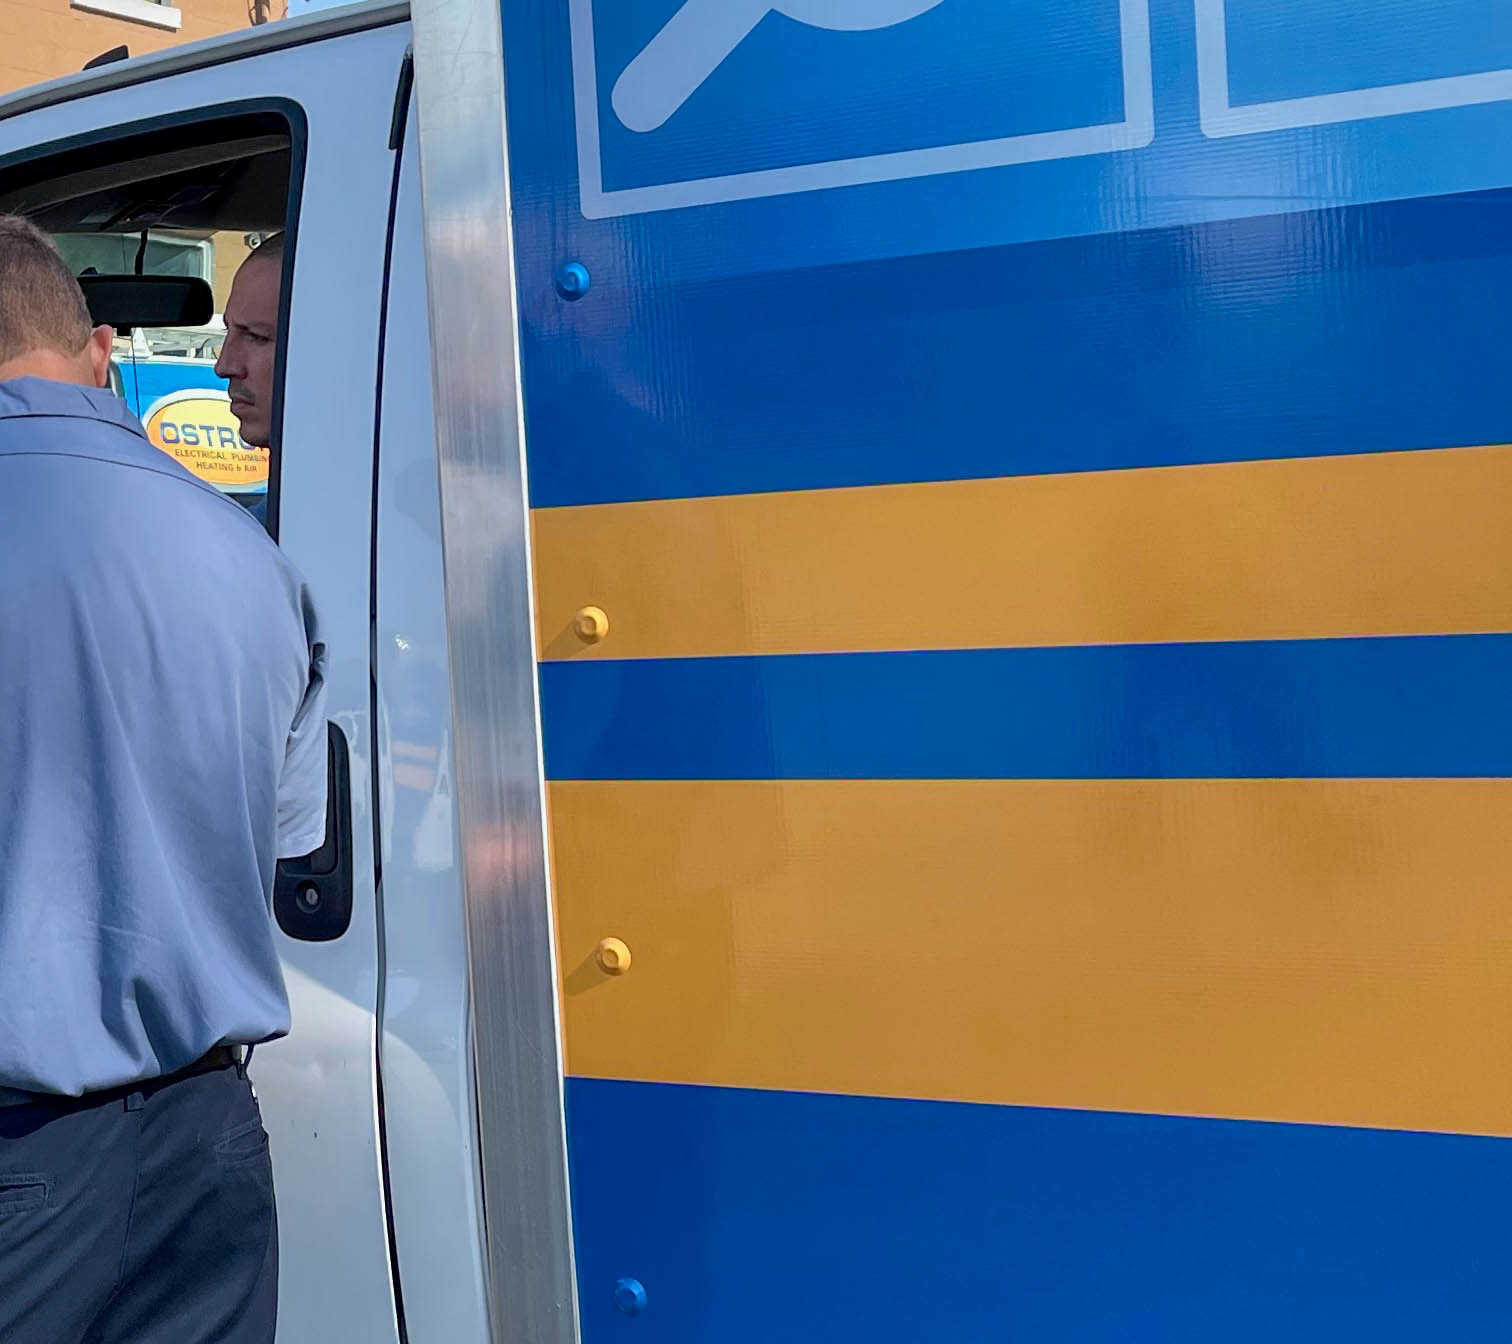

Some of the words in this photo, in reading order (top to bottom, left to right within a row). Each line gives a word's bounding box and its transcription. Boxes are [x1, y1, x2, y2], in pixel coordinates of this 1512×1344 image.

[160, 422, 256, 450] OSTR
[175, 448, 226, 460] ELECTRICAL
[196, 461, 234, 472] HEATING
